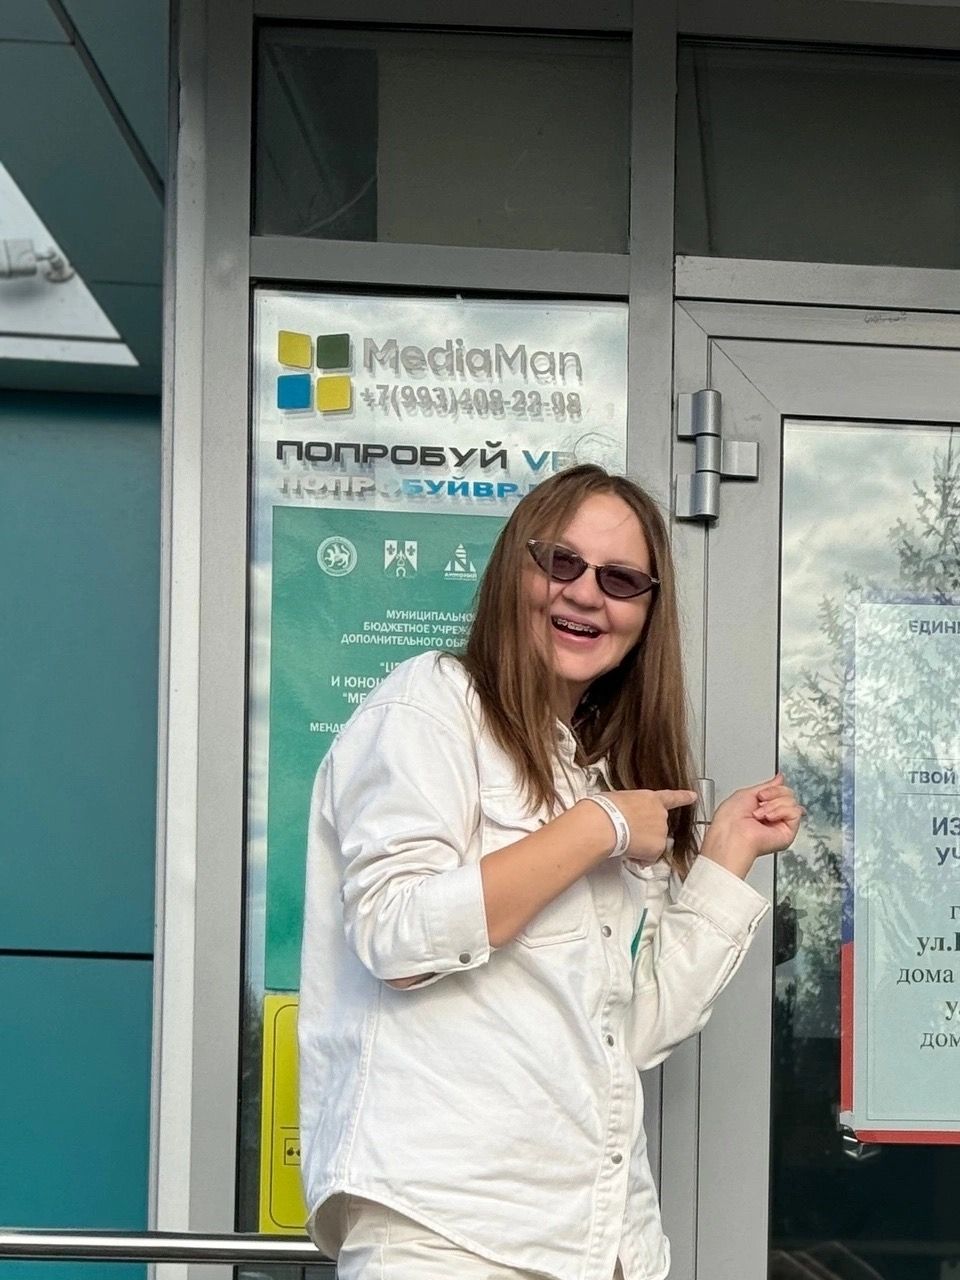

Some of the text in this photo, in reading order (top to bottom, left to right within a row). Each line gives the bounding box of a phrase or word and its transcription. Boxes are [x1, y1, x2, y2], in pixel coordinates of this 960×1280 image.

[363, 337, 583, 382] MediaMan
[277, 440, 507, 470] ПОПРОБУЙ
[363, 622, 429, 633] БЮДЖЕТНОЕ
[341, 634, 442, 647] ДОПОЛНИТЕЛЬНОГО
[331, 676, 340, 686] И
[909, 768, 955, 785] ТВОЙ
[897, 969, 953, 985] дома
